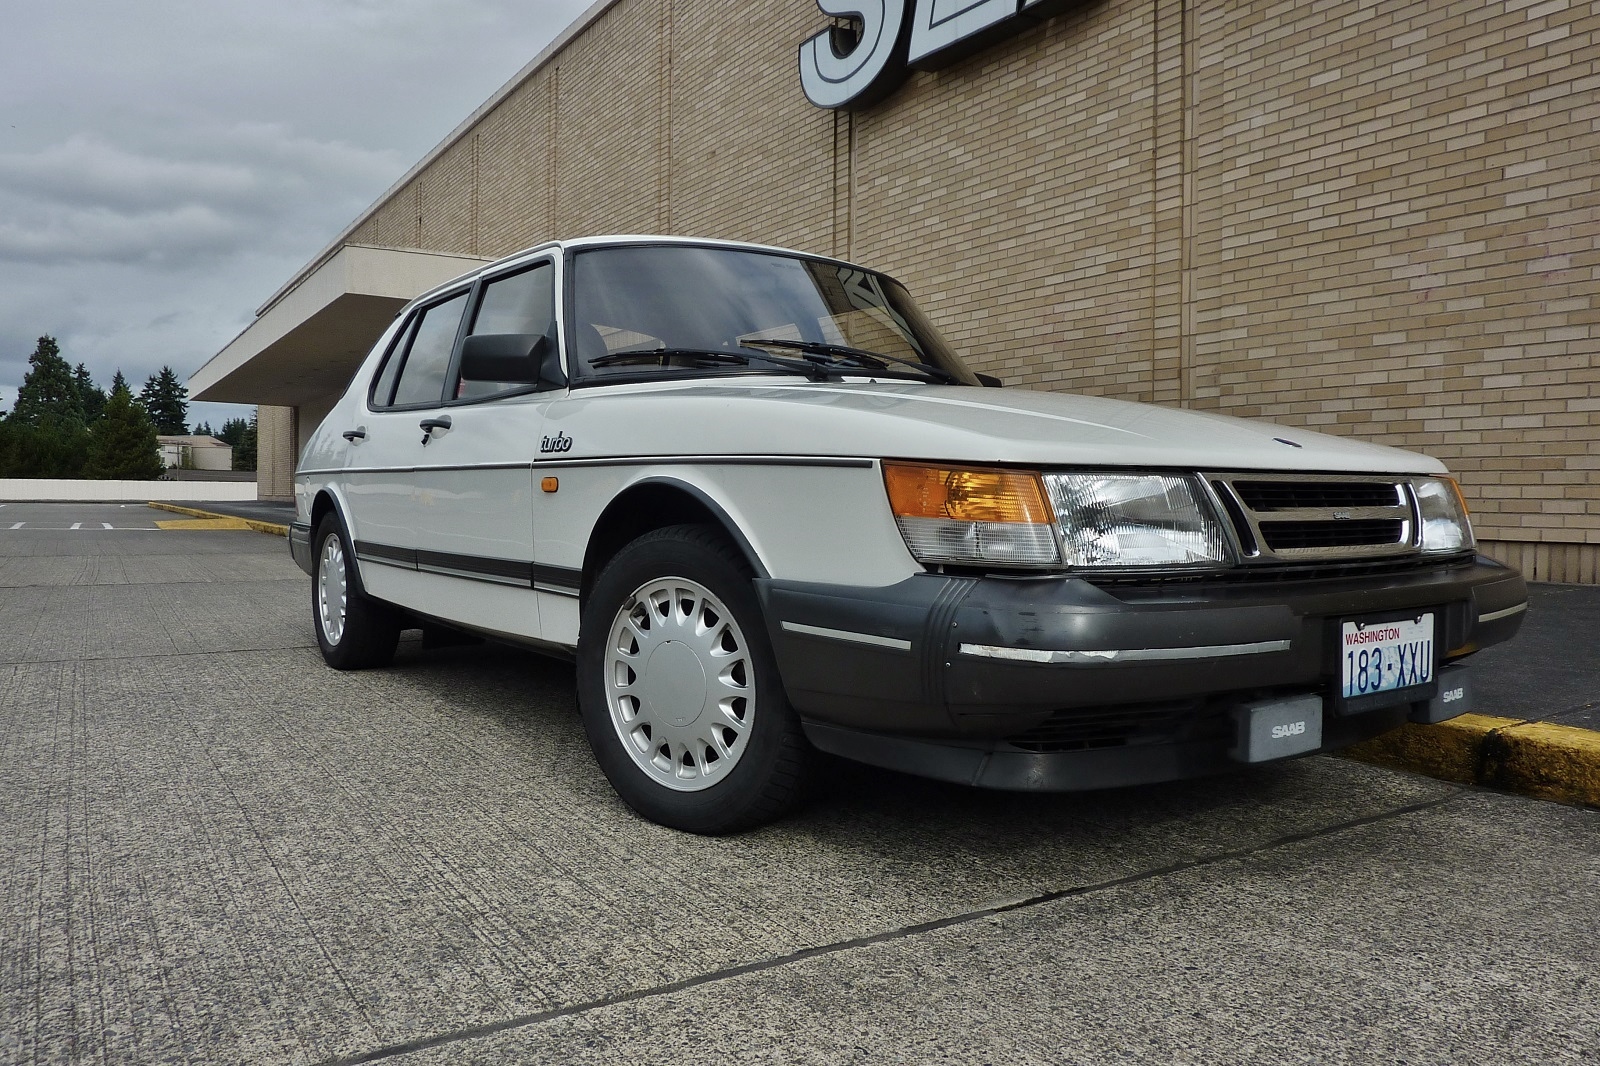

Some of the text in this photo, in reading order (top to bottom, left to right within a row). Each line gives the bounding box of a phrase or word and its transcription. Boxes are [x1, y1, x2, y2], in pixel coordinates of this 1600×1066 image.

[540, 430, 573, 453] turbo
[1345, 628, 1400, 646] WASHINGTON
[1347, 640, 1431, 696] 183-XXU
[1442, 687, 1464, 703] SAAB
[1271, 721, 1306, 739] SAAB
